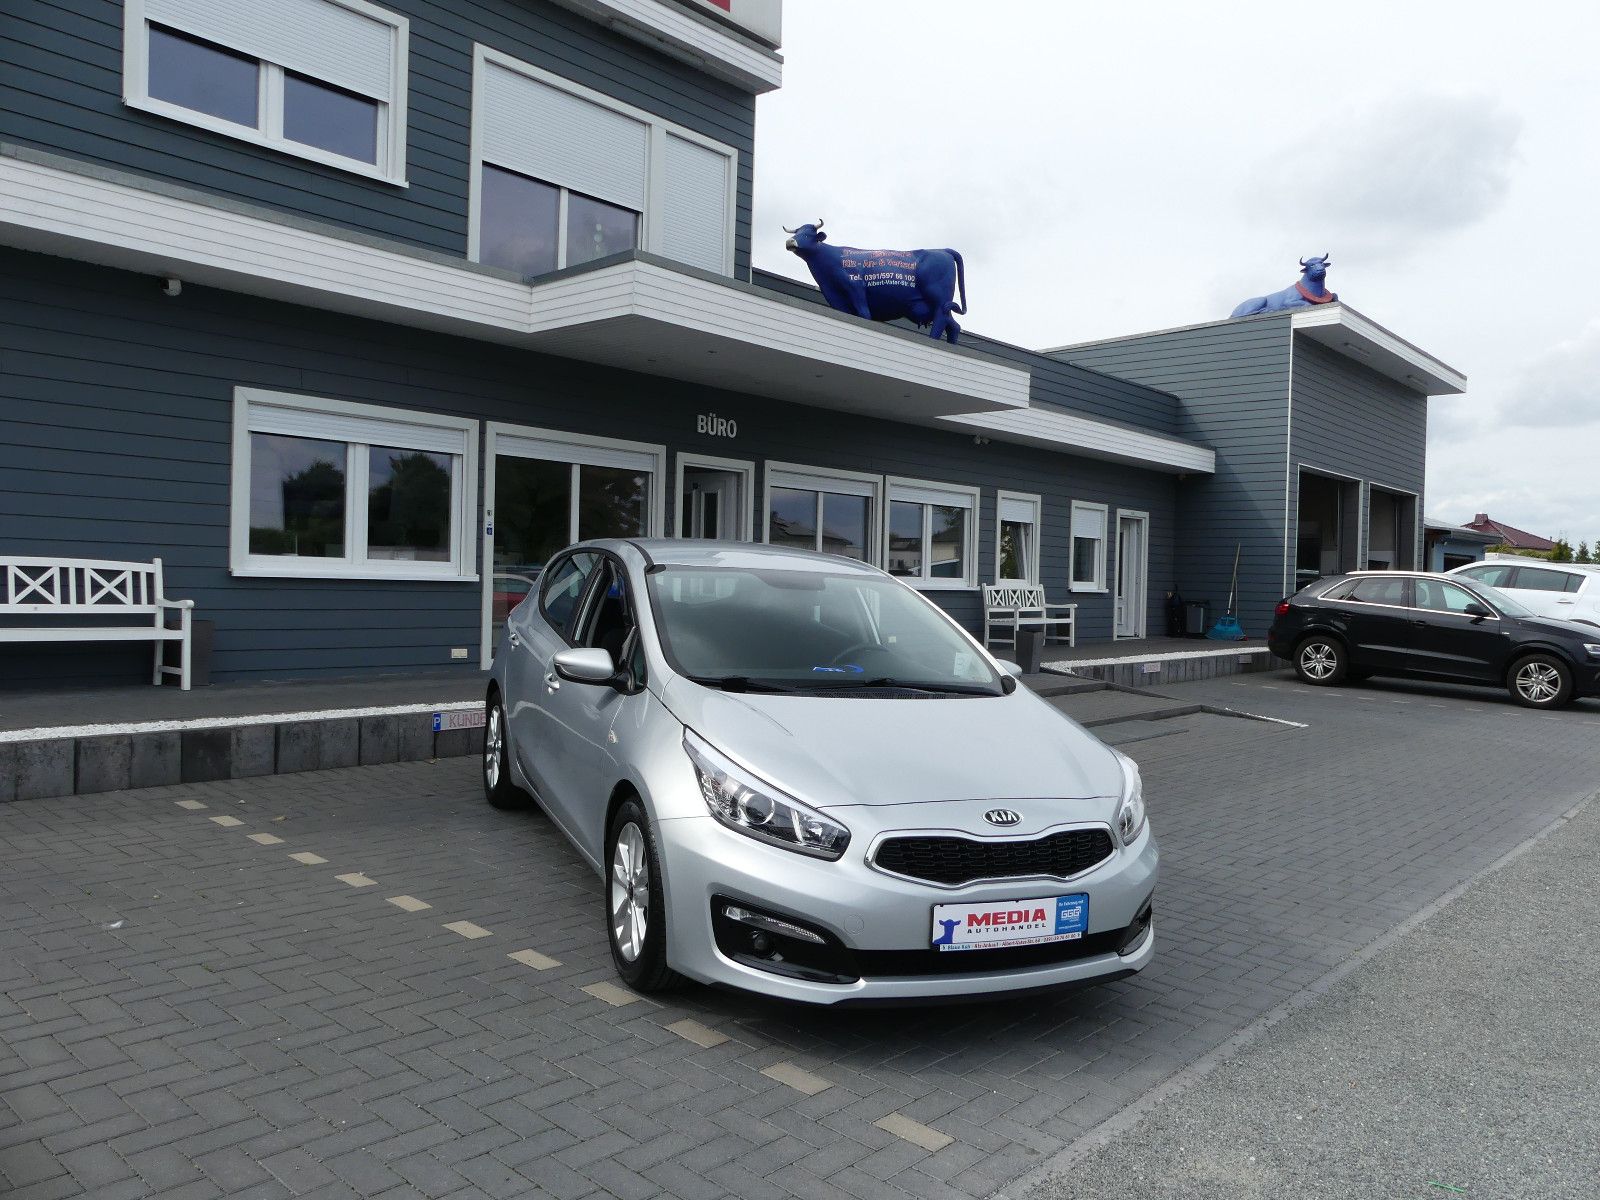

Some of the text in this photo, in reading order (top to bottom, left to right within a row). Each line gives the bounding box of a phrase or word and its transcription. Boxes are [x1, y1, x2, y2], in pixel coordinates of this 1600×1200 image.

[696, 412, 737, 438] BÜRO
[988, 810, 1018, 822] KIA
[967, 908, 1047, 927] MEDIA
[967, 923, 1046, 934] AUTOHANDEL
